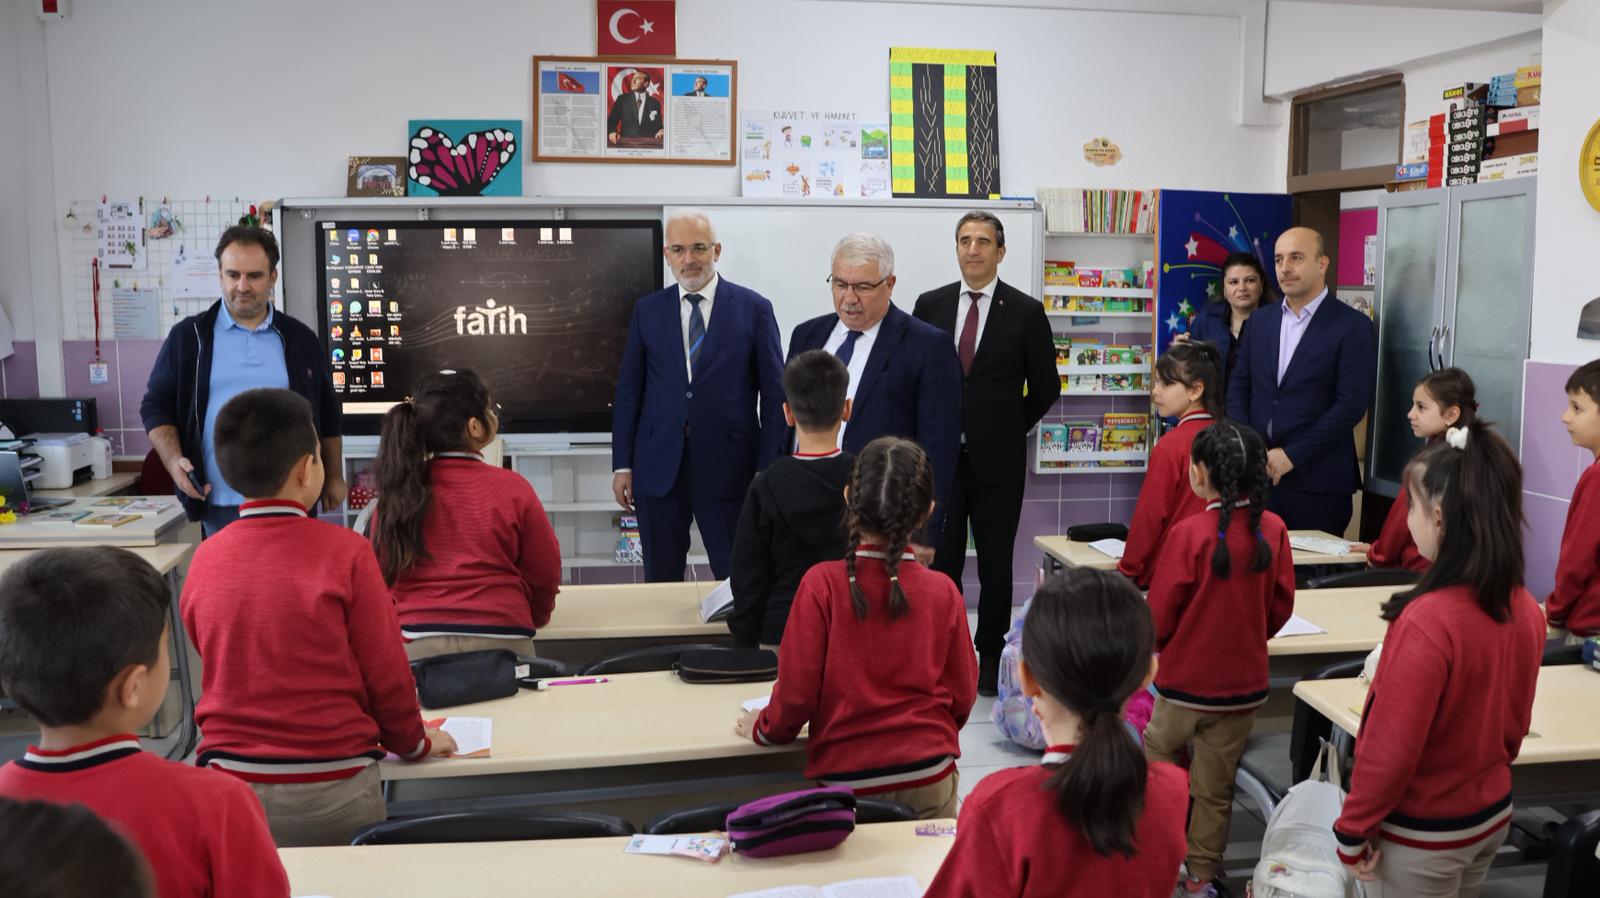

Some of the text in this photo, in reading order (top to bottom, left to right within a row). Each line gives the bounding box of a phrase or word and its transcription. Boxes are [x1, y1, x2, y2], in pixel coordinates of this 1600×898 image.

[773, 111, 806, 121] KUVVET
[824, 112, 857, 121] HAREKET
[453, 299, 528, 336] fatih
